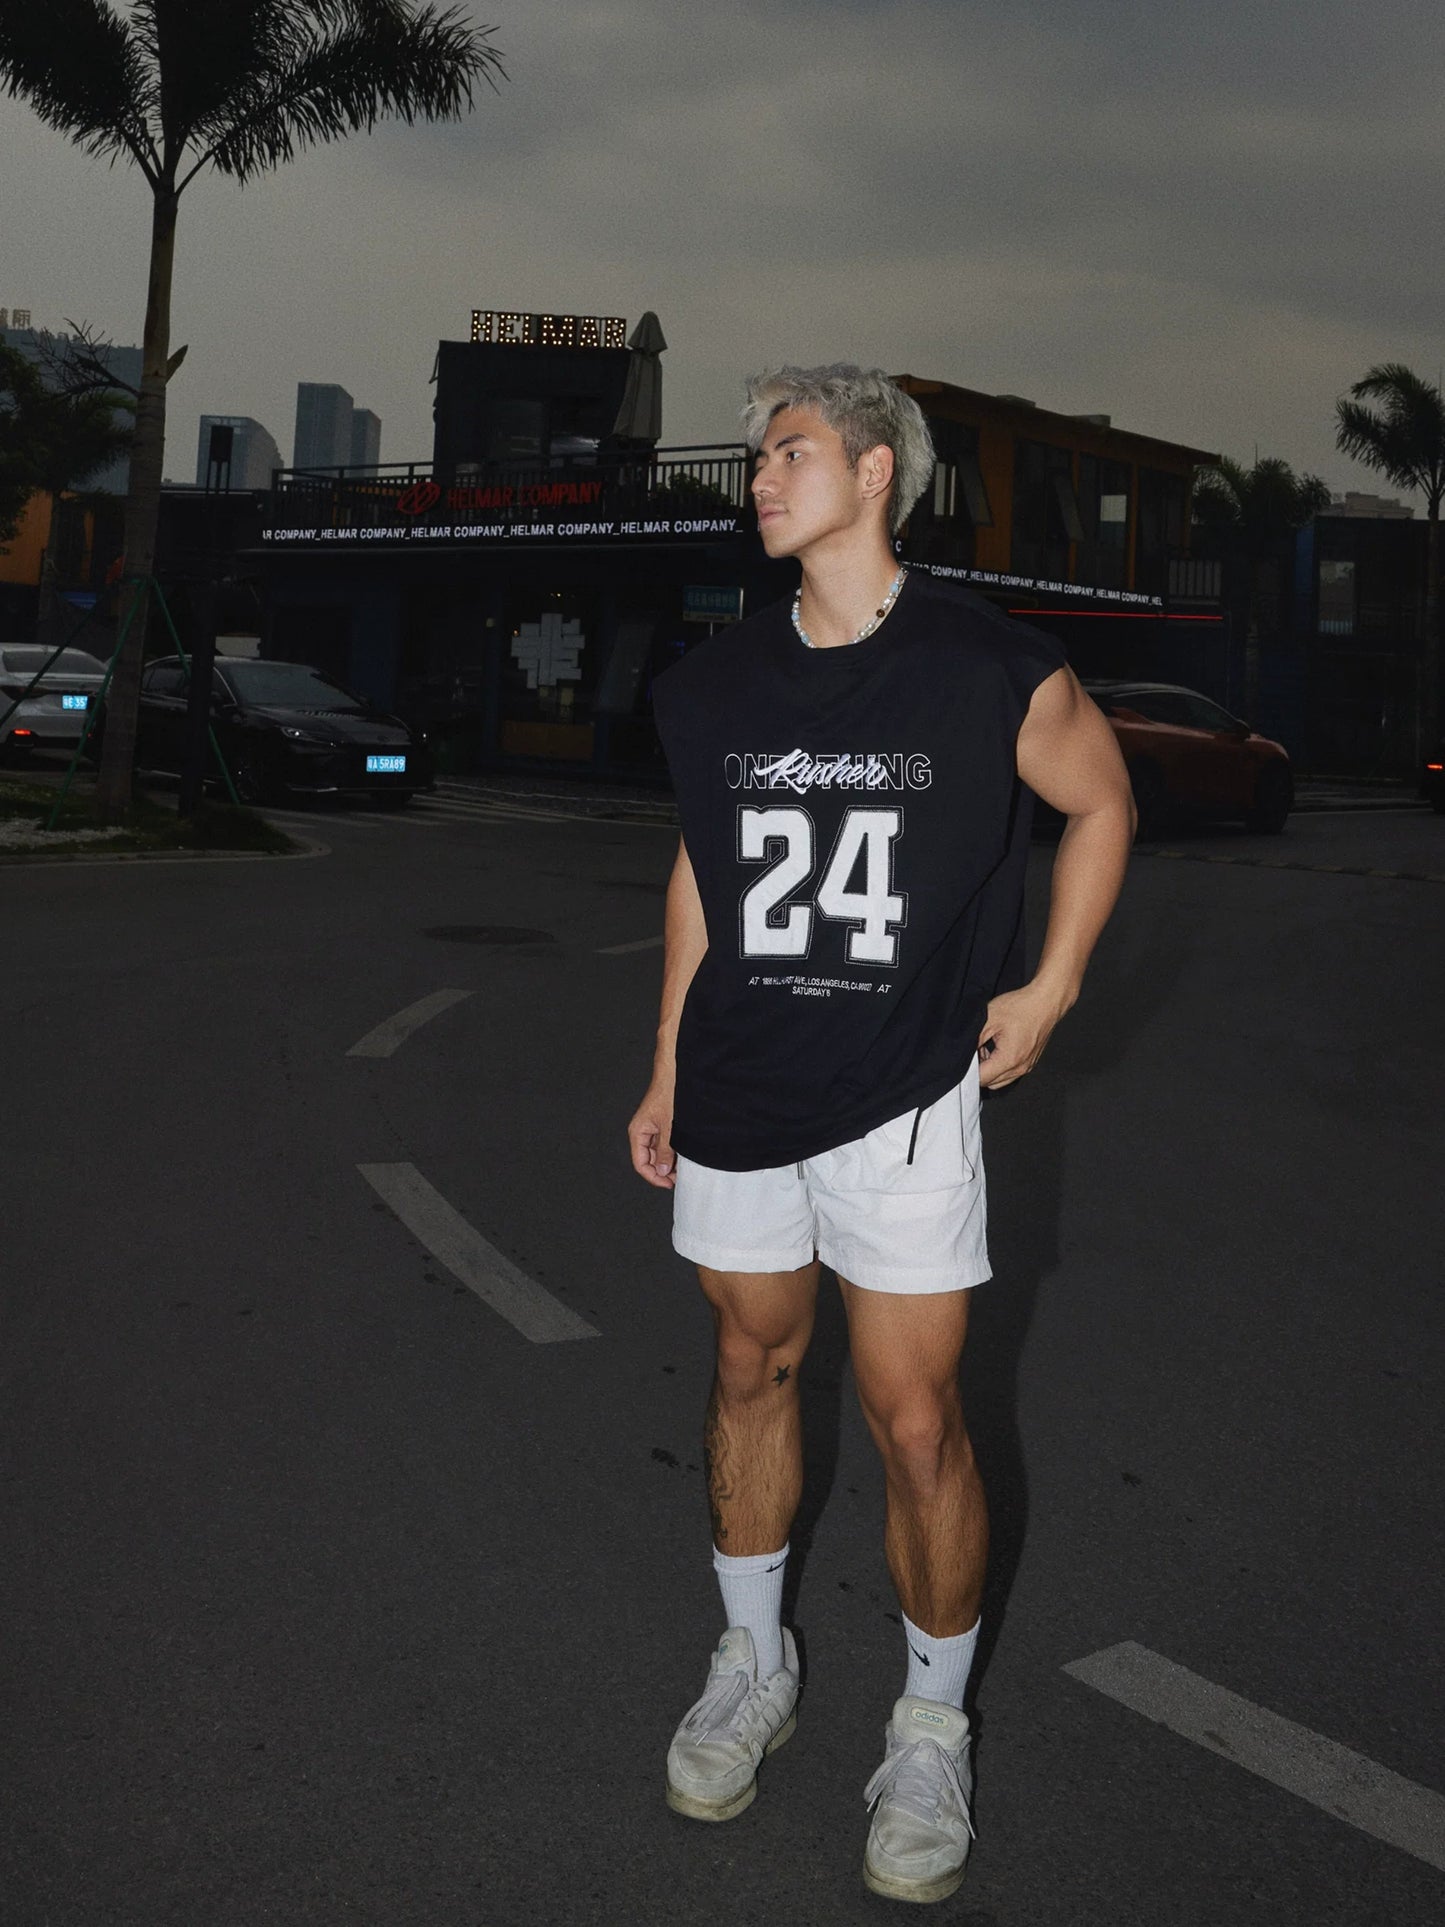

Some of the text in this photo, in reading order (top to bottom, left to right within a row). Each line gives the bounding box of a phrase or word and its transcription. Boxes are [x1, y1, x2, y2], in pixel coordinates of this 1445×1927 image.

[471, 310, 626, 349] HELMAR
[447, 482, 603, 510] HELMAR COMPANY
[737, 804, 909, 968] 24
[748, 976, 760, 986] AT
[877, 984, 892, 994] AT
[915, 1711, 945, 1725] adidas
